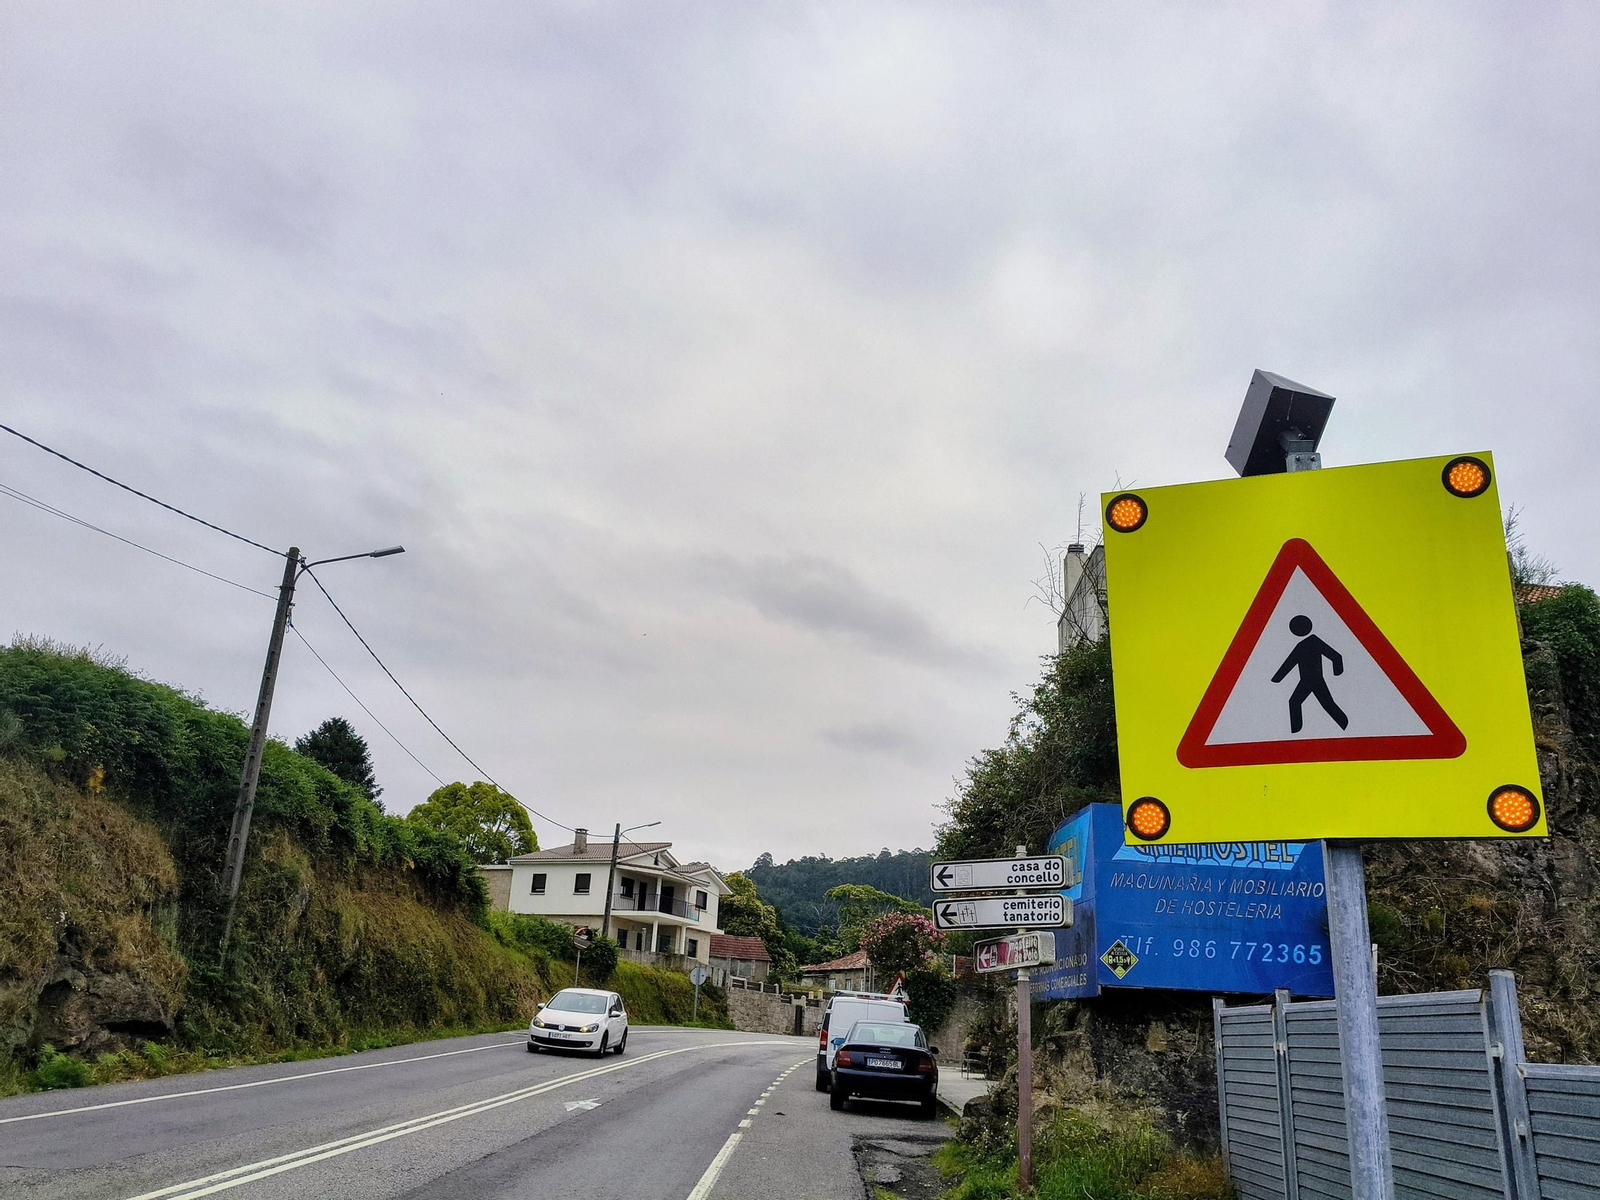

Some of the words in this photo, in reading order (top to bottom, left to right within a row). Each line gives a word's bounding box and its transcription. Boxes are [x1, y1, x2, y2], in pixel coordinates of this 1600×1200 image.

[1011, 862, 1039, 872] casa
[1044, 860, 1060, 871] do
[1006, 871, 1060, 884] concello
[1110, 872, 1212, 893] MAQUINARIA
[1216, 878, 1227, 893] Y
[1229, 878, 1324, 898] MOBILIARIO
[1003, 899, 1060, 910] cemiterio
[1155, 899, 1178, 914] DE
[1181, 899, 1282, 920] HOSTELERIA
[1003, 910, 1060, 922] tanatorio
[1173, 938, 1217, 959] 986
[1229, 941, 1322, 965] 772365
